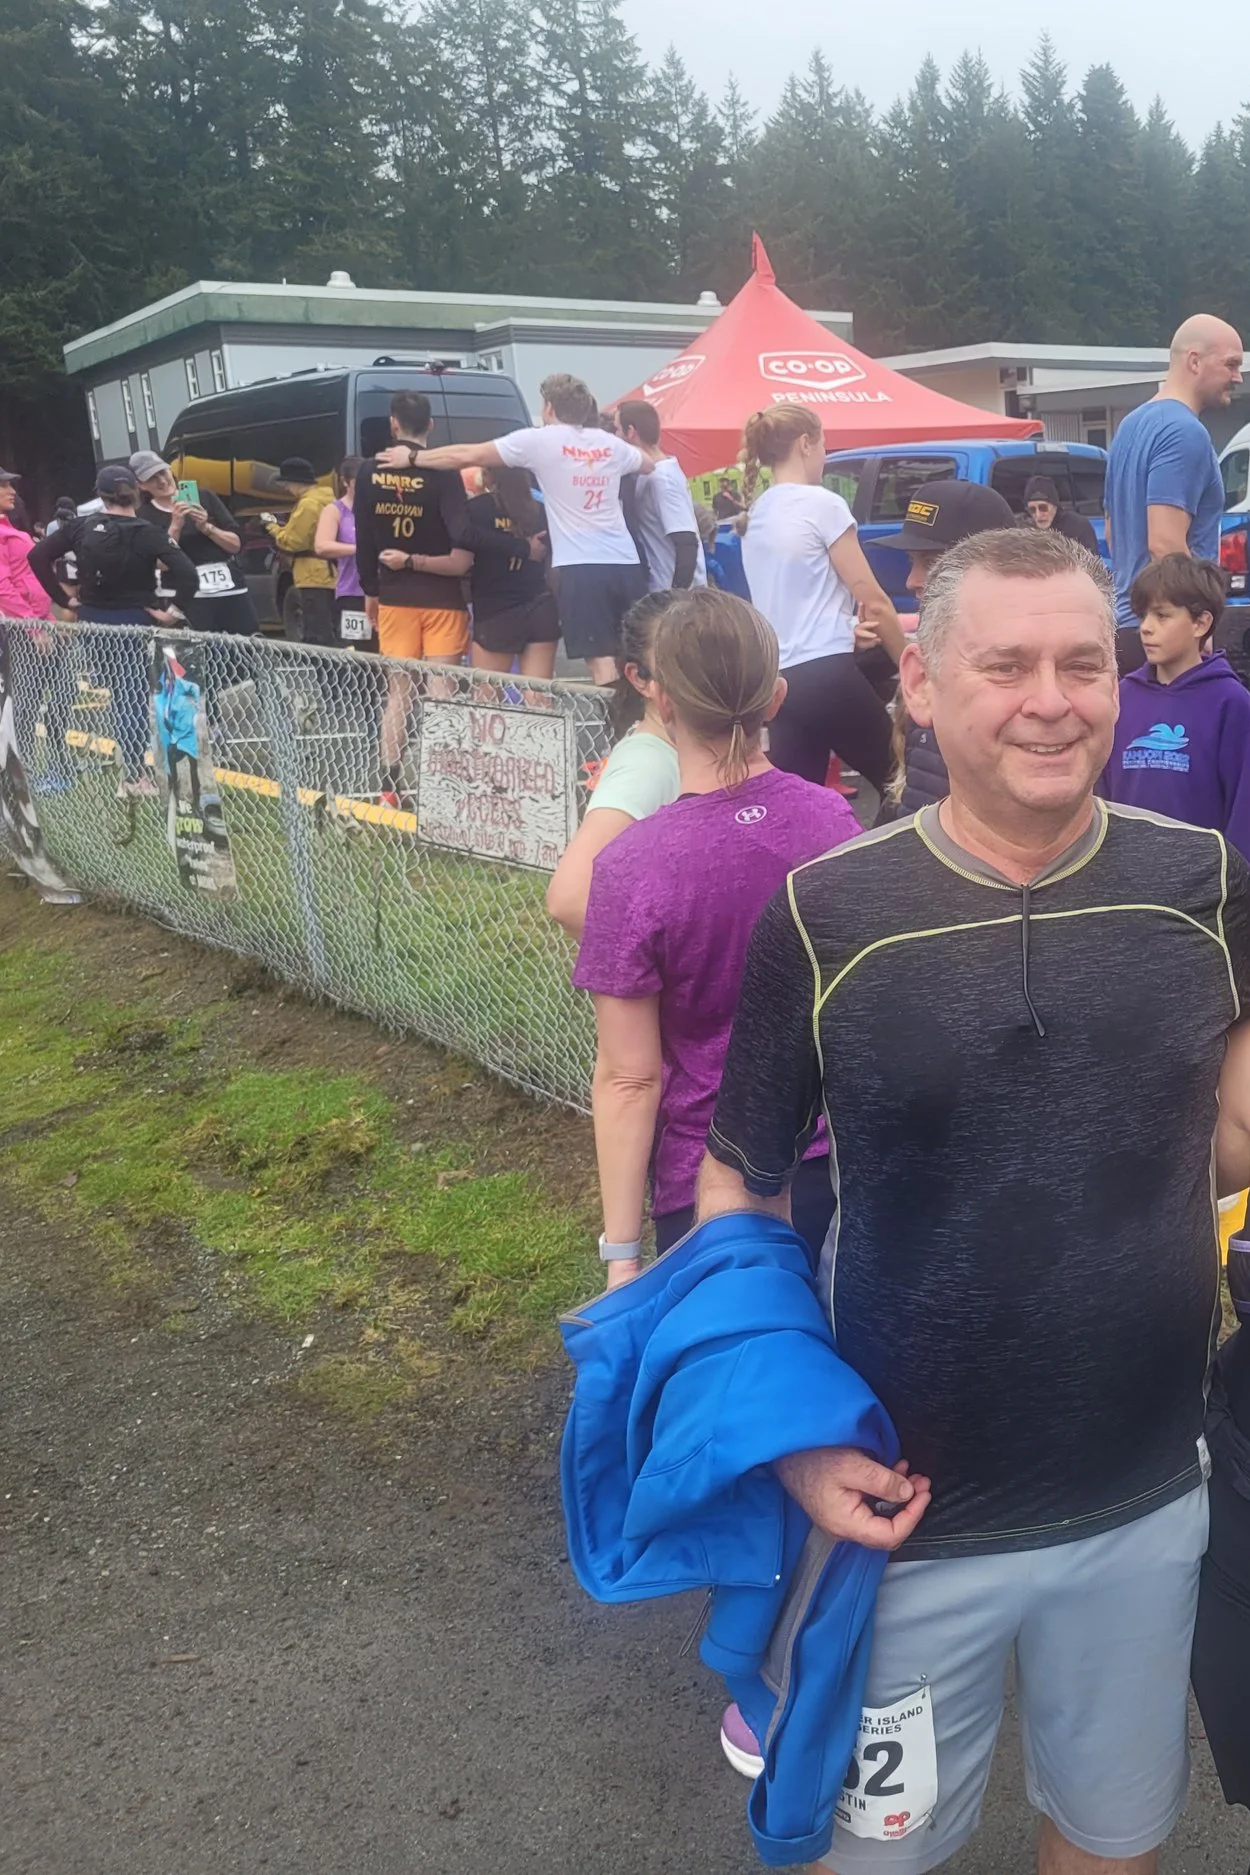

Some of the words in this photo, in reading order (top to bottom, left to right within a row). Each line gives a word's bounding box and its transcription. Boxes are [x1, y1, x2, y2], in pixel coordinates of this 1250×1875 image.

[771, 391, 892, 404] PENINSULA
[372, 472, 424, 489] NMRC
[392, 516, 415, 538] 10
[200, 569, 227, 584] 175
[345, 618, 364, 631] 301
[469, 711, 505, 745] NO
[877, 1706, 923, 1725] ISLAND
[839, 1791, 866, 1811] STIN
